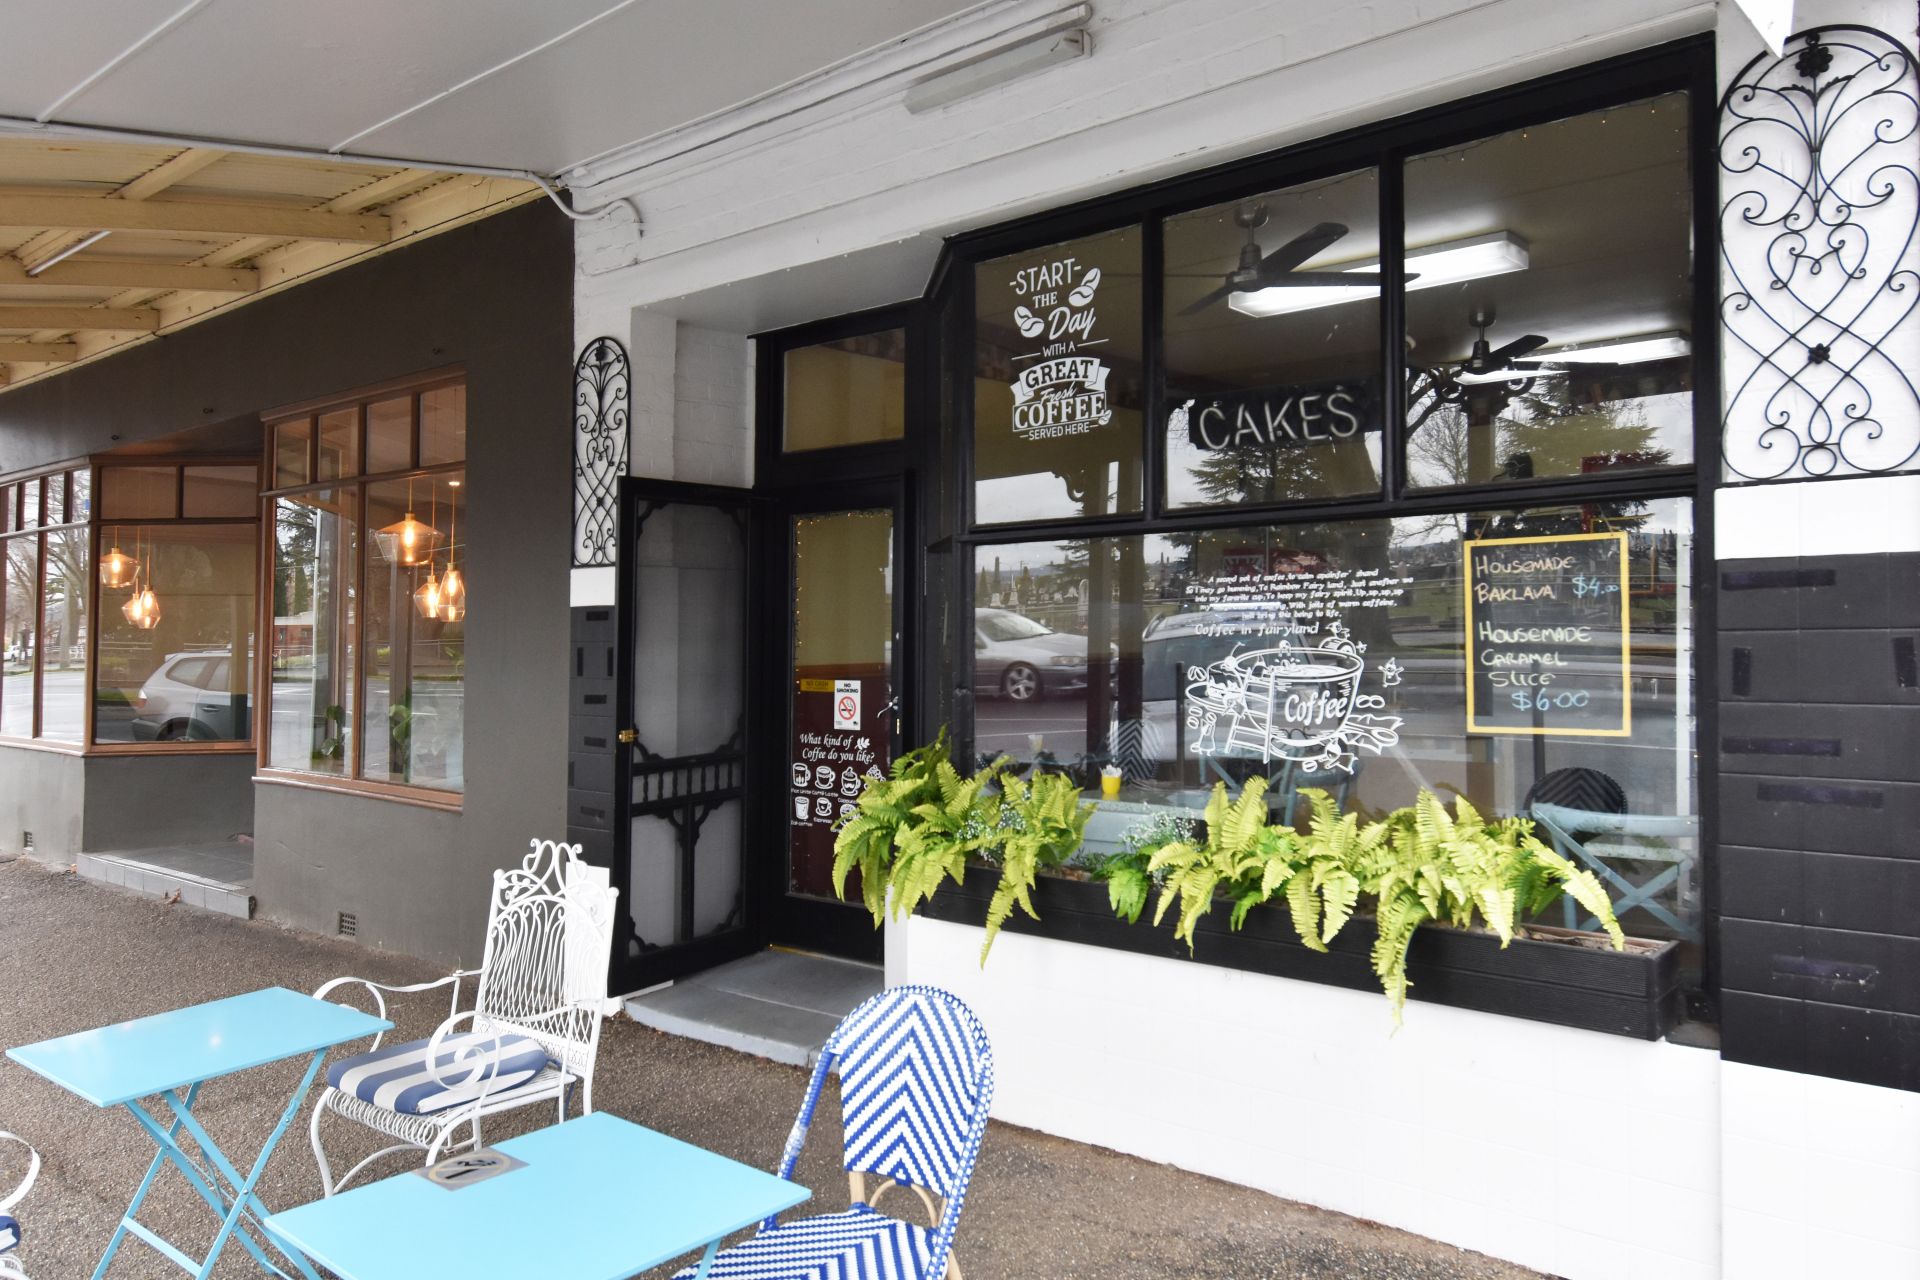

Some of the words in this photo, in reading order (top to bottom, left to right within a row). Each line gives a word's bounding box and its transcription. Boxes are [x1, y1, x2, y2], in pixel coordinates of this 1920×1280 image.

[1032, 291, 1058, 309] THE
[1048, 306, 1096, 340] Day
[1042, 342, 1066, 358] WITH
[1068, 340, 1076, 352] A
[1025, 359, 1094, 389] GREAT
[1039, 381, 1077, 404] Fresh
[1014, 393, 1105, 429] COFFEE
[1199, 392, 1358, 450] CAKES
[1028, 425, 1063, 441] SERVED
[1065, 423, 1090, 436] HERE
[1474, 582, 1556, 604] BAKLAVA
[1195, 623, 1235, 637] Coffee
[1241, 623, 1252, 635] in
[1257, 622, 1319, 637] fairyland
[1481, 648, 1568, 667] CARAMEL
[1488, 671, 1556, 687] SLICE
[1284, 690, 1347, 725] Coffee
[800, 733, 821, 745] What
[823, 734, 841, 746] kind
[842, 735, 853, 750] of
[802, 747, 826, 762] Coffee
[827, 748, 838, 760] do
[838, 752, 854, 764] you
[855, 751, 875, 765] like?
